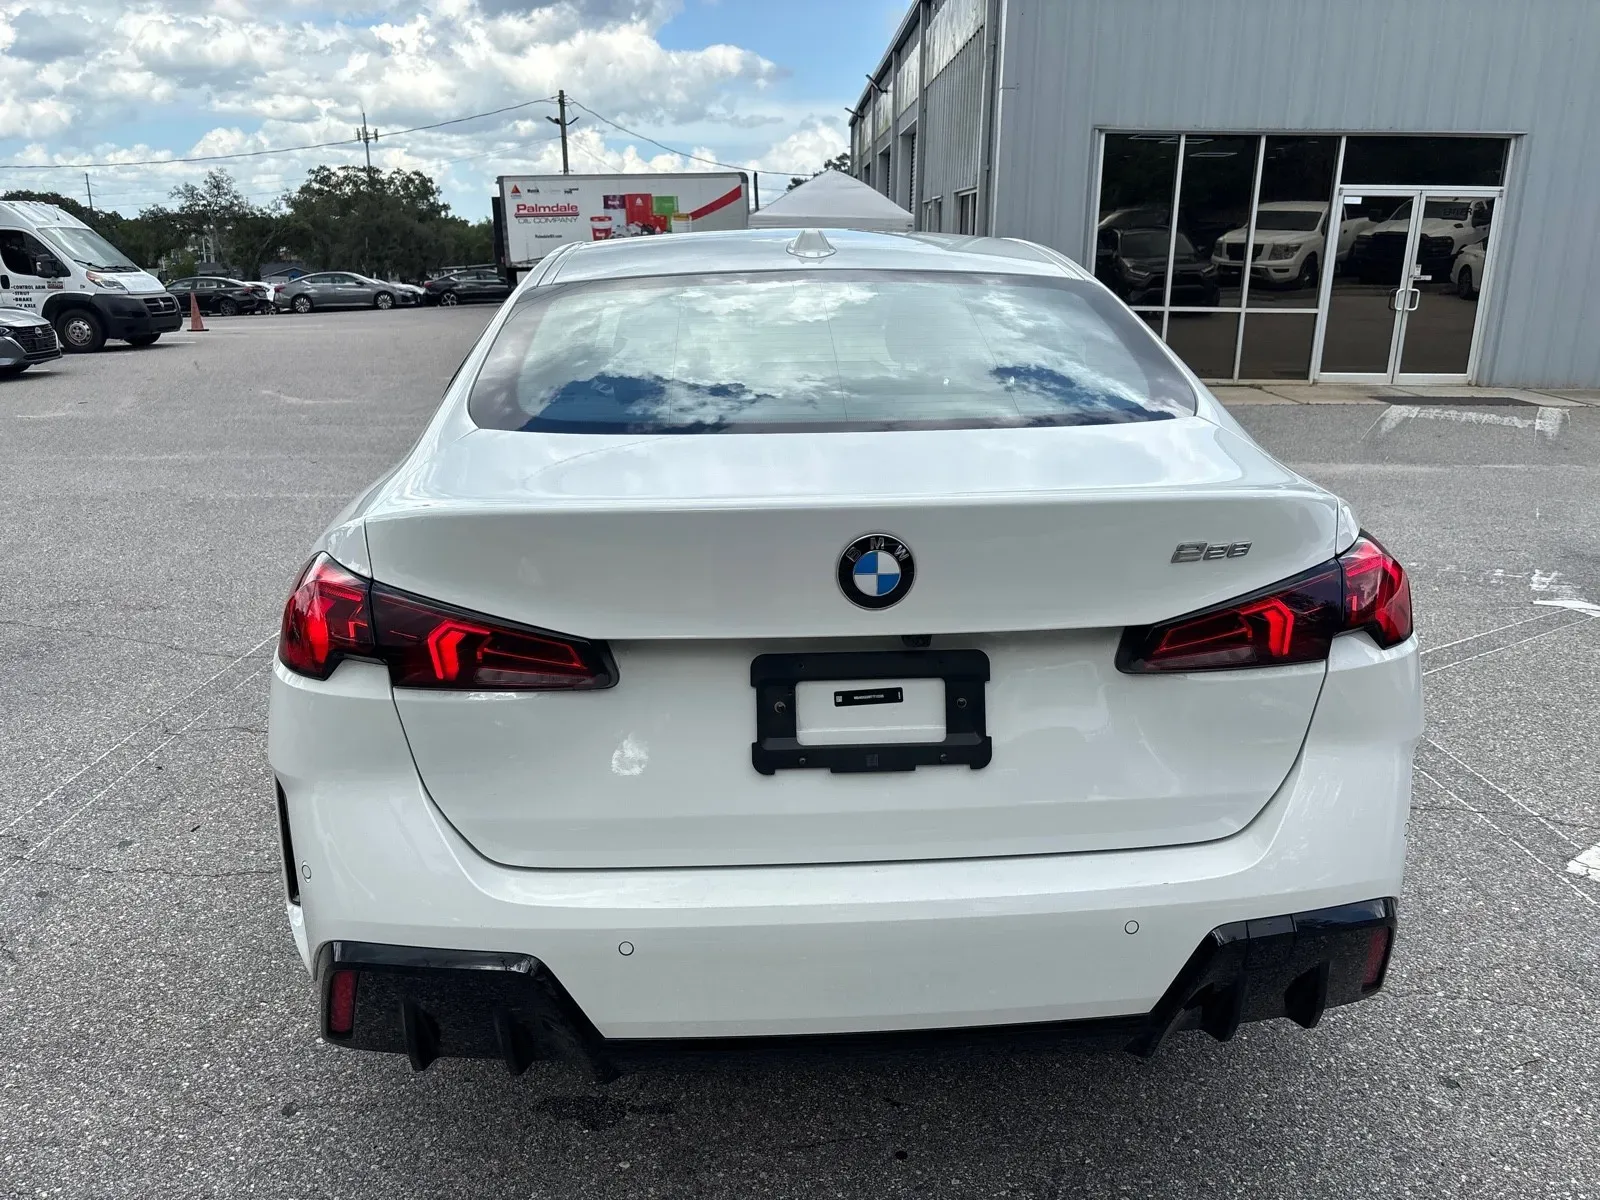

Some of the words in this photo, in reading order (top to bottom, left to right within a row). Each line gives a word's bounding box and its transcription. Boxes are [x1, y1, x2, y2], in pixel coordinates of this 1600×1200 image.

[516, 203, 578, 213] Palmdale
[533, 216, 578, 225] COMPANY
[846, 537, 910, 563] BMW
[1171, 540, 1252, 564] 228
